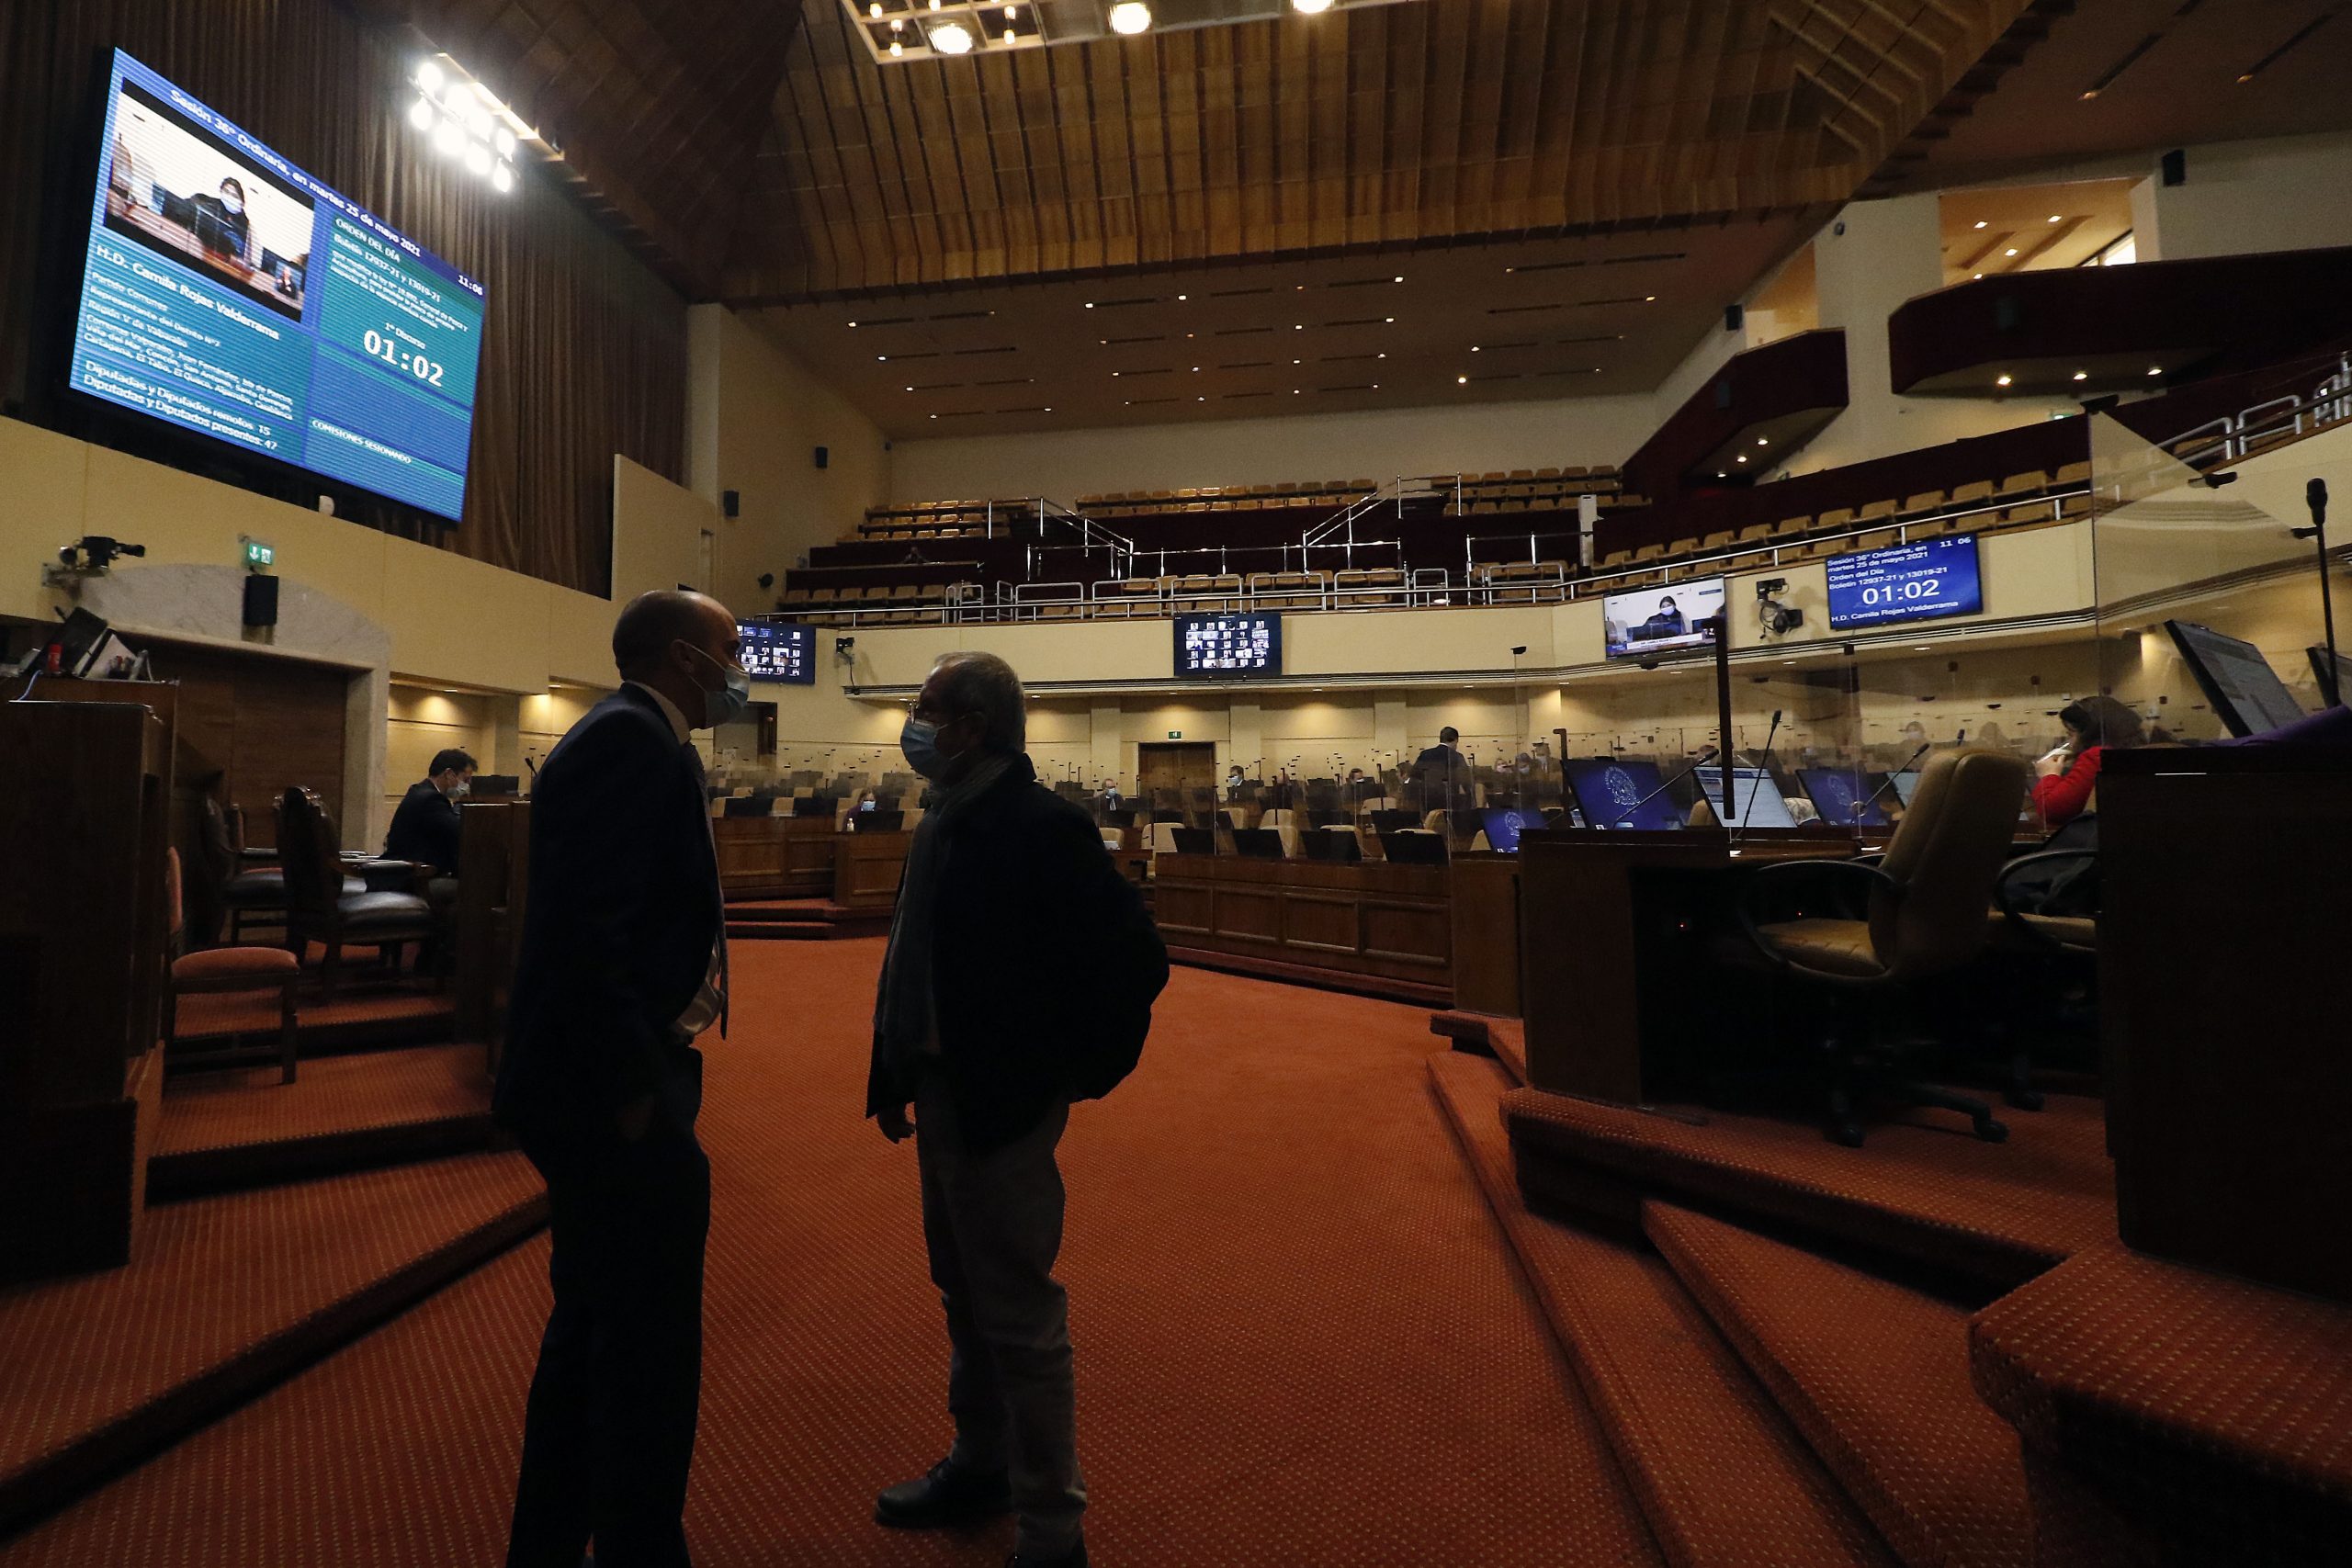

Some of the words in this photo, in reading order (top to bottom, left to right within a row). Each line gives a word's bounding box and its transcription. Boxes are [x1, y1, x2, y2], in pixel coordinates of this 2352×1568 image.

[170, 89, 211, 122] Sesión
[292, 172, 307, 185] en
[309, 182, 344, 208] martes
[345, 203, 358, 217] 25
[359, 213, 373, 226] de
[374, 222, 399, 243] mayo
[400, 237, 420, 256] 2021
[335, 219, 367, 241] ORDEN
[368, 237, 382, 252] DEL
[384, 247, 400, 262] DÍA
[96, 244, 128, 268] H.D.
[132, 263, 176, 290] Camila
[179, 284, 213, 308] Rojas
[216, 301, 278, 339] Valderrama
[364, 330, 442, 386] 01:02
[84, 374, 144, 403] Diputadas
[155, 400, 210, 426] Diputados
[264, 440, 277, 449] 47
[85, 360, 147, 389] Diputadas
[157, 387, 211, 413] Diputados
[258, 424, 270, 435] 15
[312, 420, 363, 444] COMISIONES
[365, 440, 411, 462] SESIONANDO
[1826, 558, 1854, 566] Sesión
[1859, 574, 1895, 584] 12937-21
[1906, 567, 1947, 577] 13019-21
[1905, 551, 1928, 559] 2021
[1828, 573, 1854, 581] Orden
[1862, 579, 1939, 604] 01:02
[1850, 611, 1879, 619] Camila
[1906, 601, 1958, 611] Valderrama
